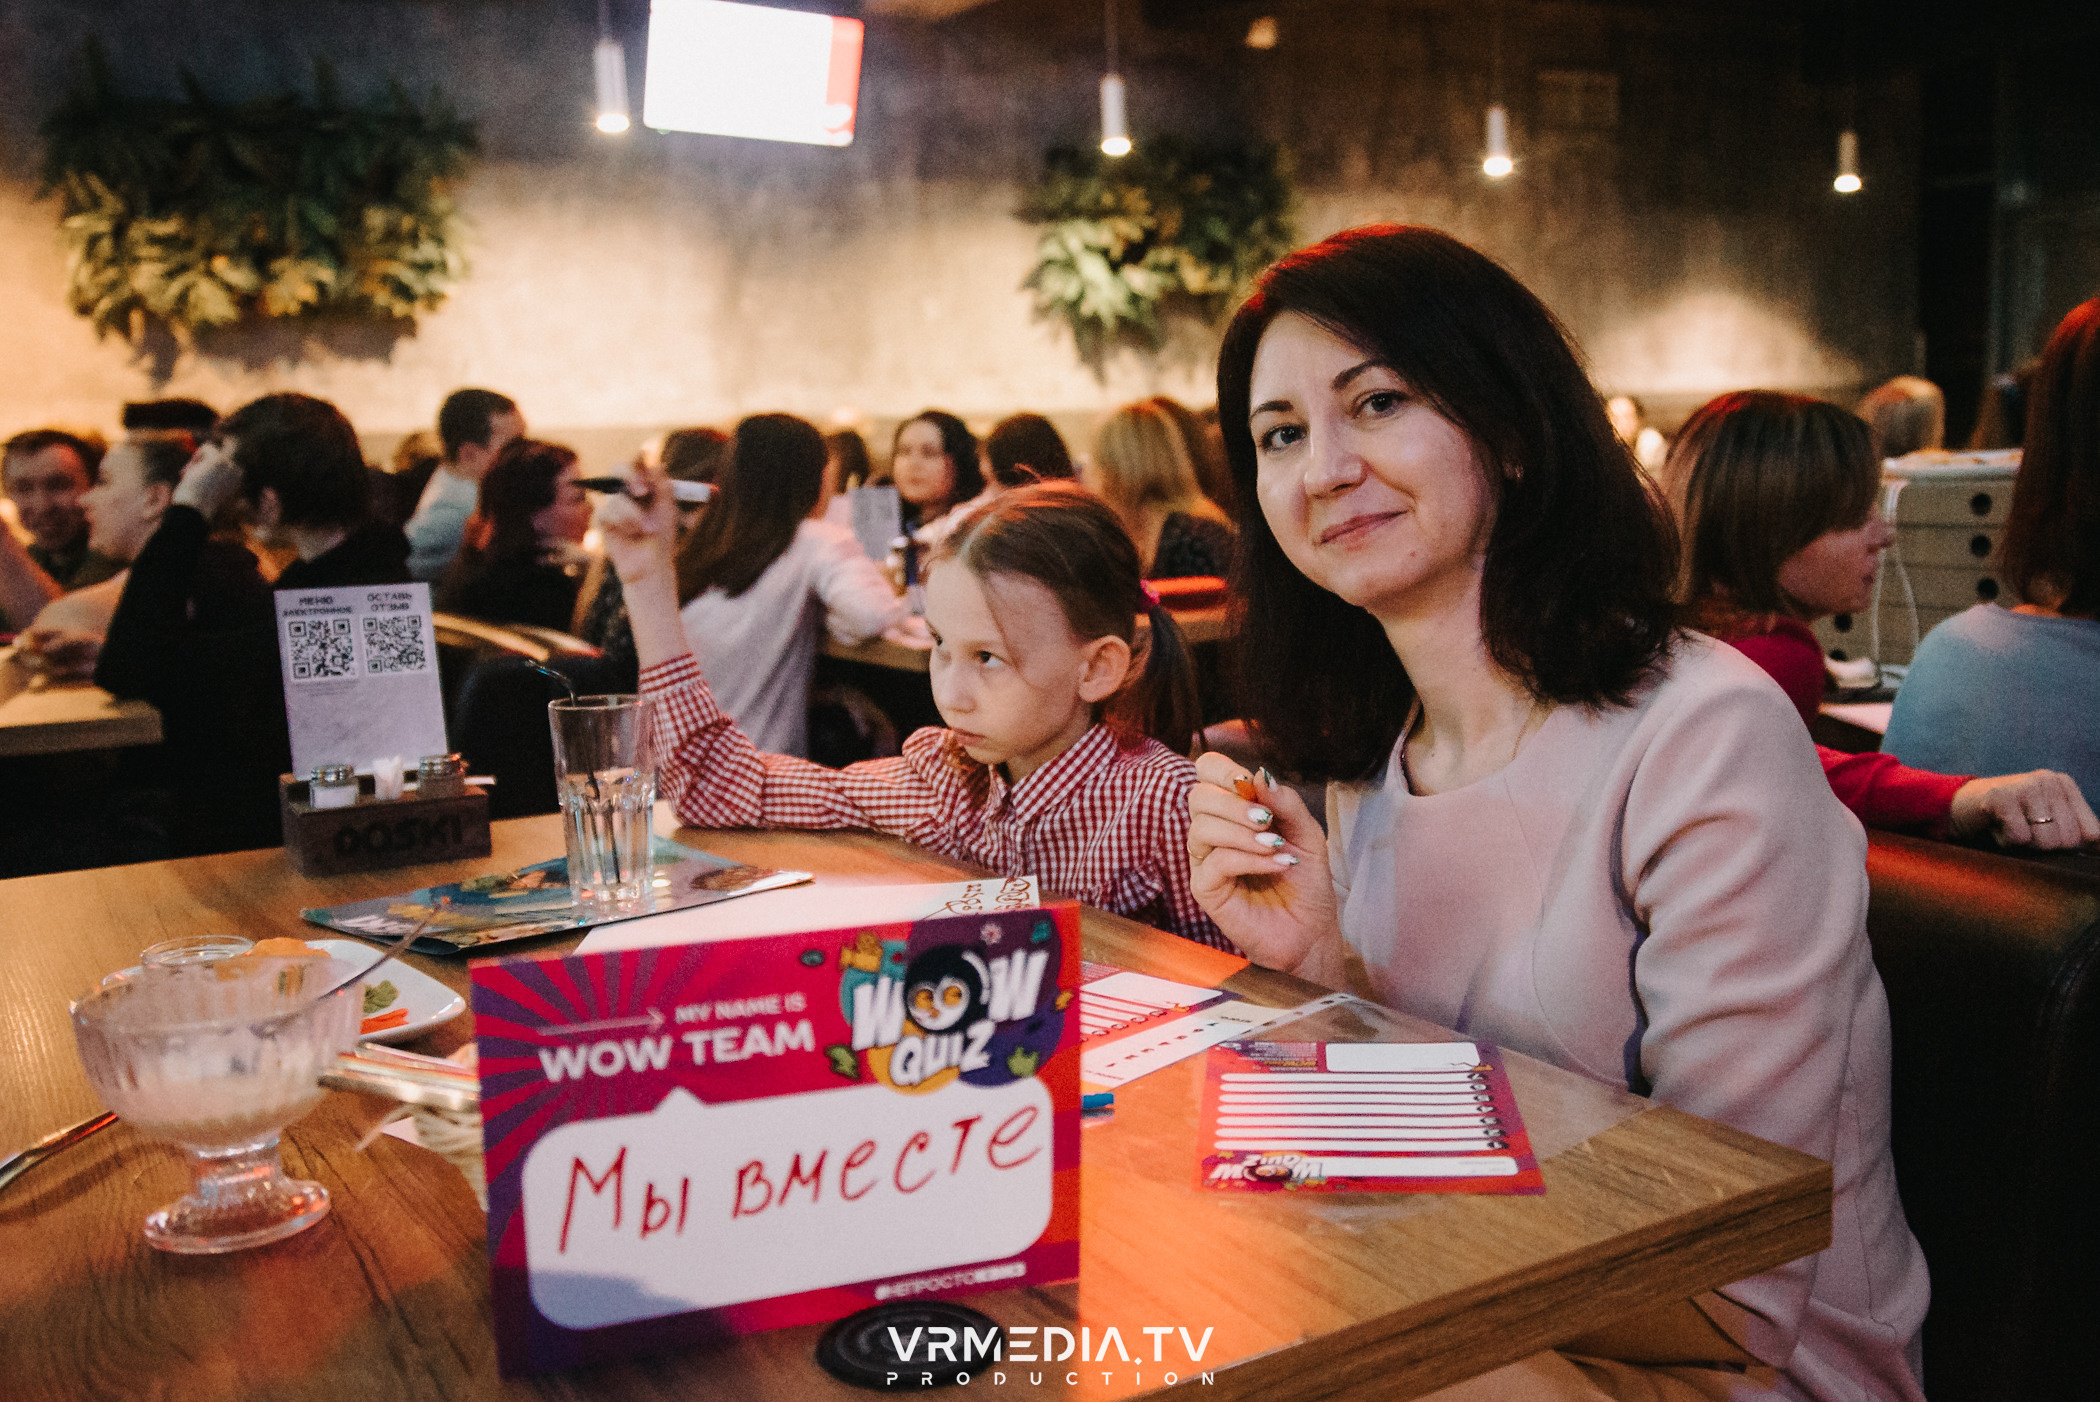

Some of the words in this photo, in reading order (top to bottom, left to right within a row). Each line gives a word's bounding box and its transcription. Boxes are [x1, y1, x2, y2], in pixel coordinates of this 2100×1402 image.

[299, 595, 334, 606] МЕНЮ
[674, 1003, 713, 1025] MY
[715, 993, 782, 1020] NAME
[784, 991, 807, 1013] IS
[538, 1034, 672, 1083] WOW
[681, 1018, 816, 1066] TEAM
[889, 1018, 996, 1086] QUIZ
[557, 1144, 692, 1255] Мы
